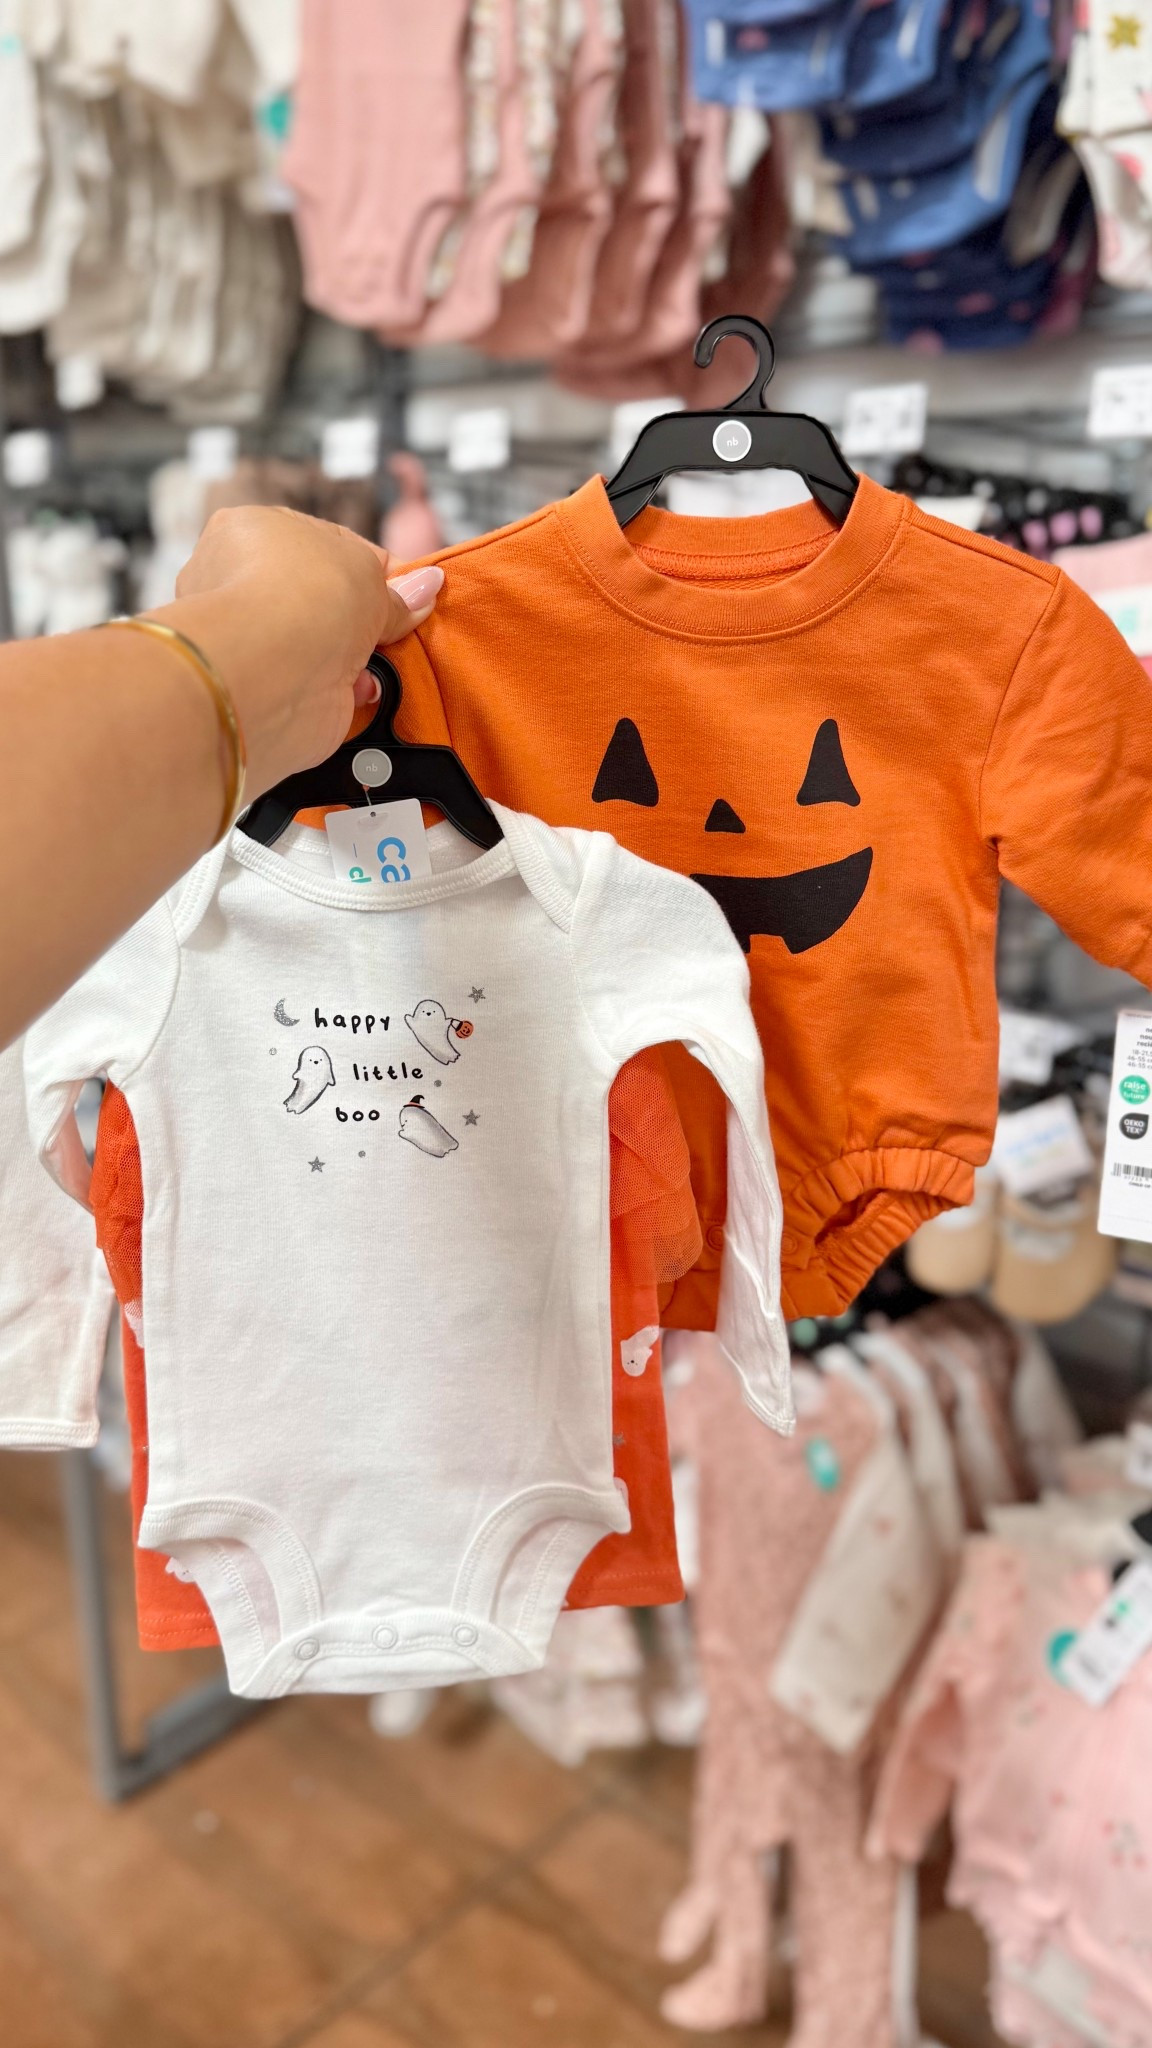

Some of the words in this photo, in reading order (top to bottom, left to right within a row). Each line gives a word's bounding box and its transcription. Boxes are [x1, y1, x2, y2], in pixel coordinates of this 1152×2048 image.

[727, 436, 739, 447] nb
[365, 763, 378, 772] nb
[314, 1007, 390, 1034] happy
[353, 1062, 424, 1082] little
[1123, 1081, 1146, 1090] raise
[335, 1106, 380, 1123] boo
[1123, 1119, 1145, 1128] OEKO
